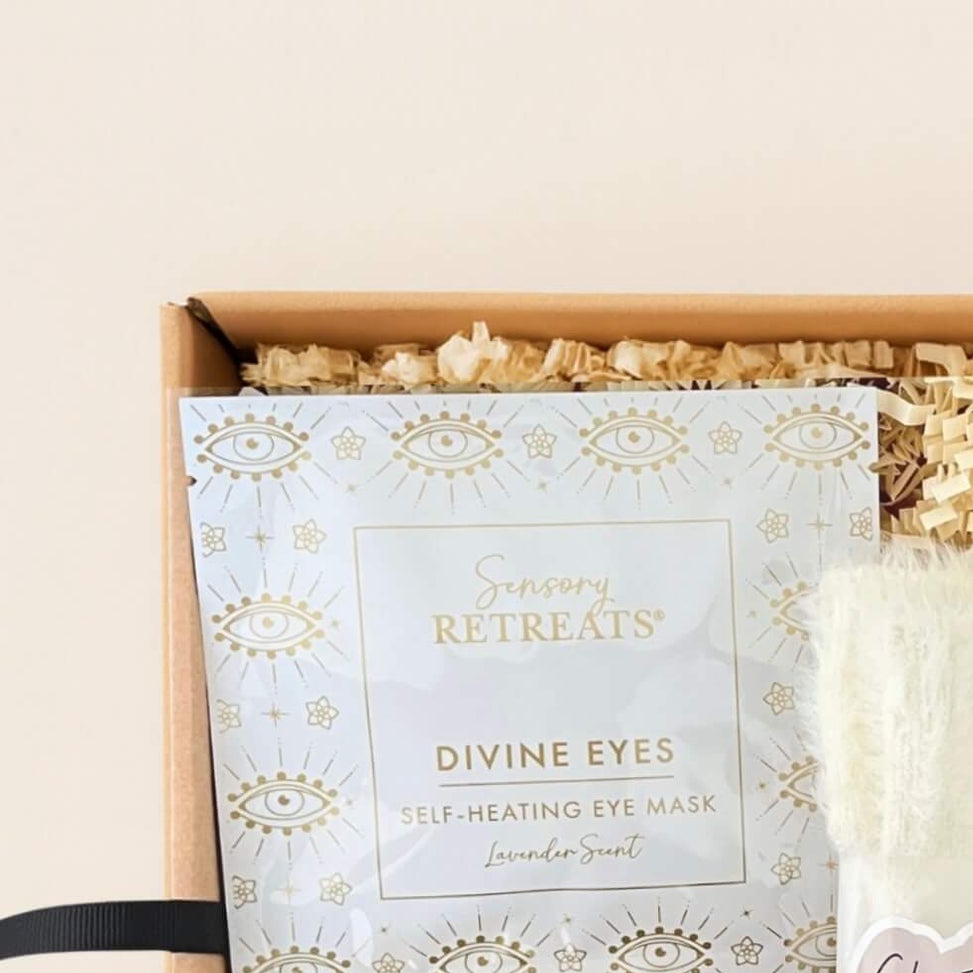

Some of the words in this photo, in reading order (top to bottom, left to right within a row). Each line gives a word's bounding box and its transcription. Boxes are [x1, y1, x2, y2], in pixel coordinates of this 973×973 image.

[475, 553, 615, 615] Sensory
[437, 742, 569, 772] DIVINE
[587, 738, 675, 766] EYES
[401, 800, 582, 824] SELF-HEATING
[593, 798, 635, 818] EYE
[646, 794, 717, 816] MASK
[484, 837, 578, 868] Lavender
[579, 833, 646, 865] Scent
